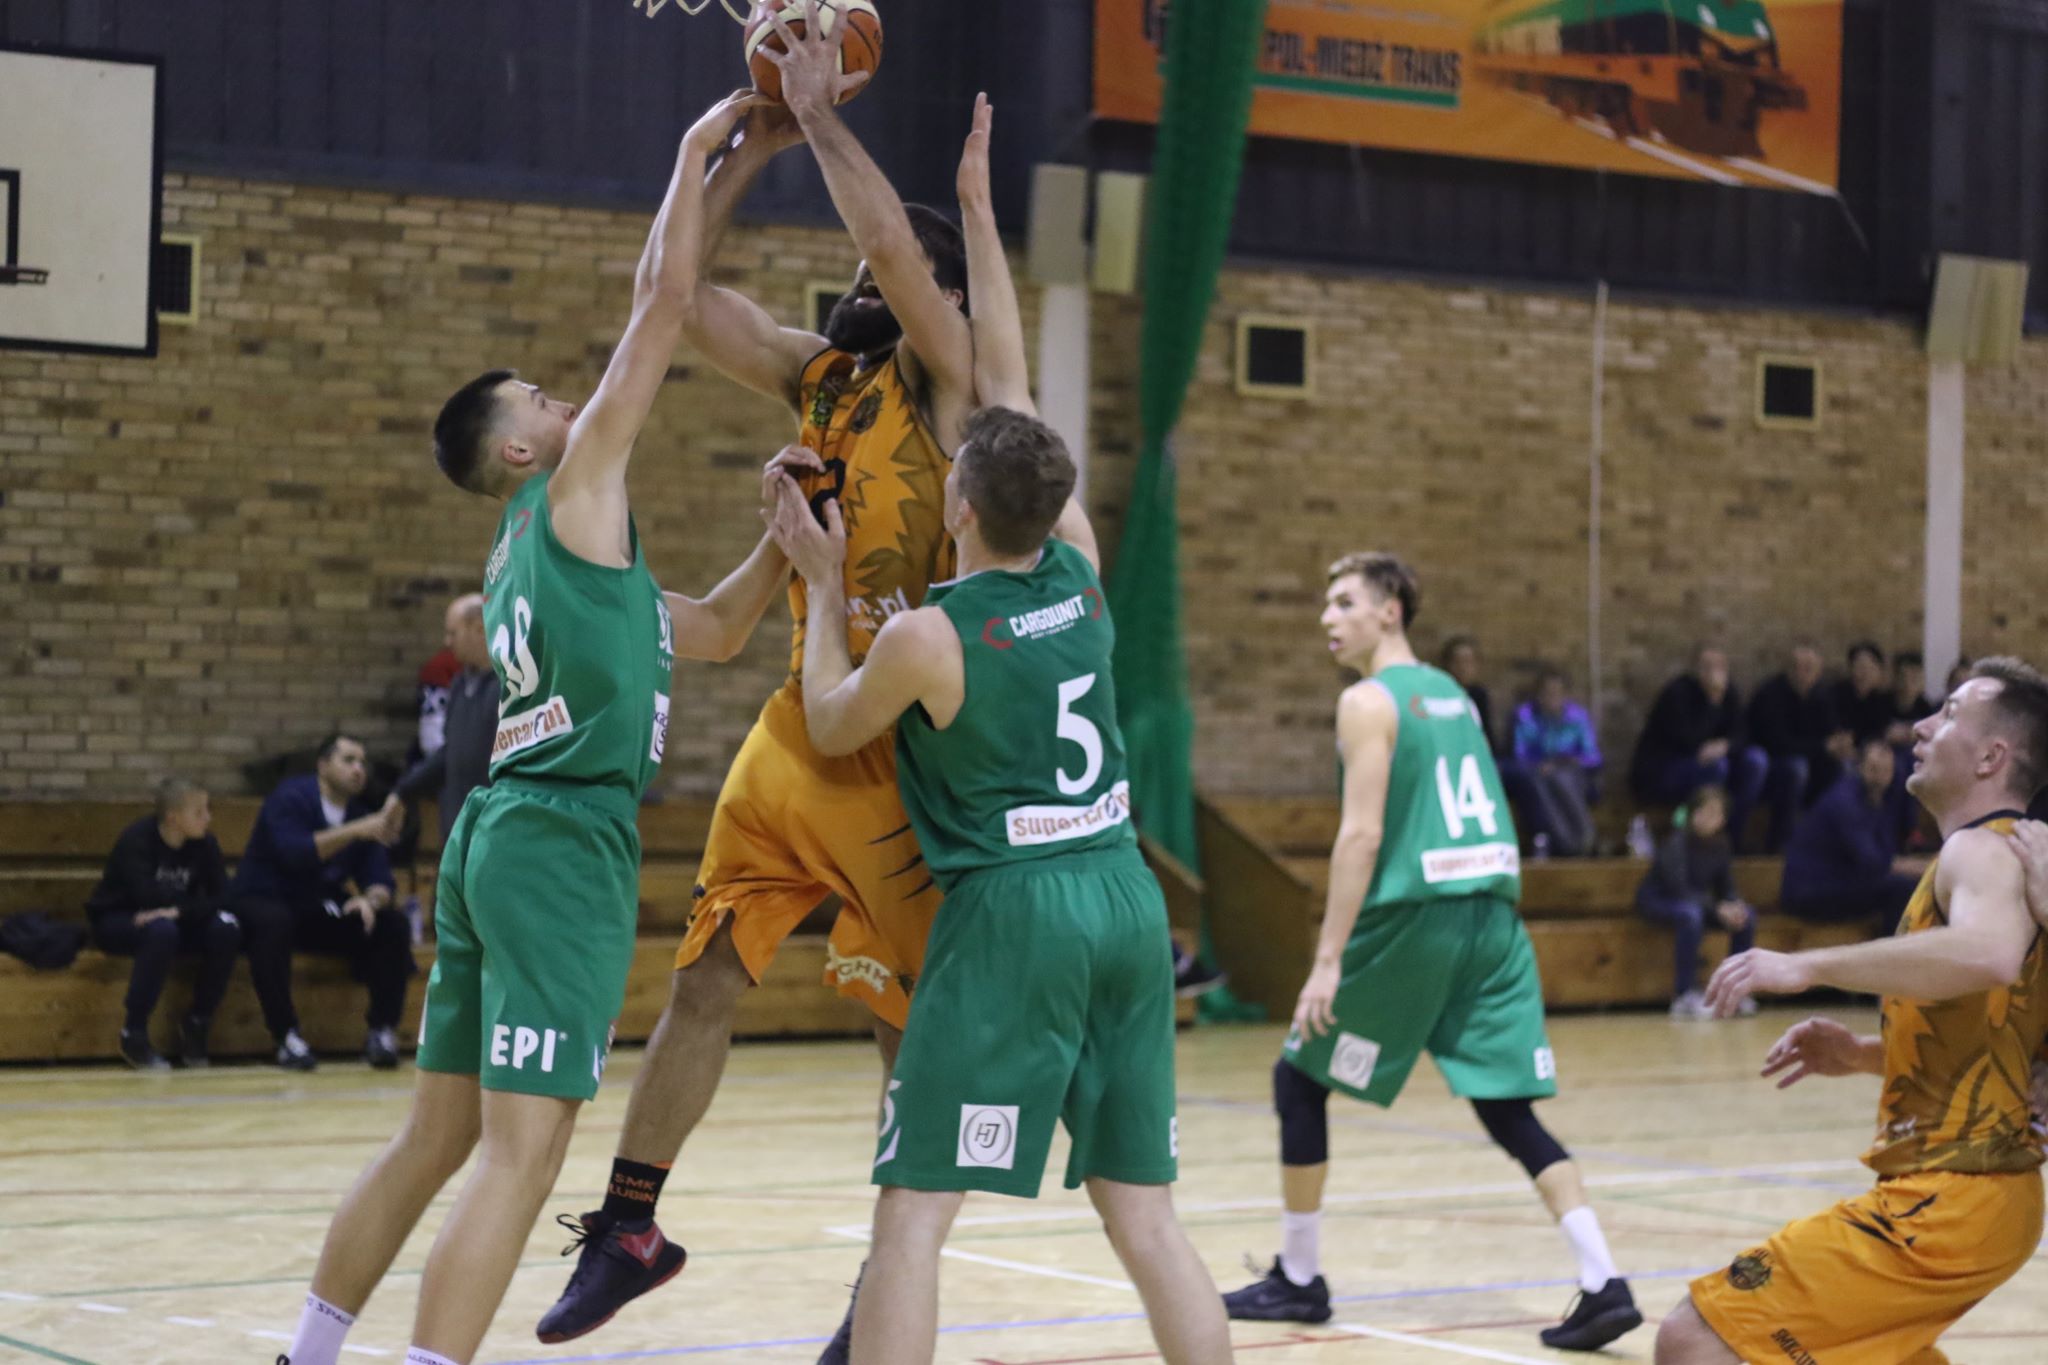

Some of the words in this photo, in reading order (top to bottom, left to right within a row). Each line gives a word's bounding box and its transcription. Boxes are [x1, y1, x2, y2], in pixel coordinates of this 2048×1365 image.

[1391, 43, 1462, 89] TRANS
[1008, 594, 1086, 638] CARGOUNIT
[1056, 672, 1104, 796] 5
[1434, 753, 1499, 840] 14
[614, 1172, 657, 1191] SMK
